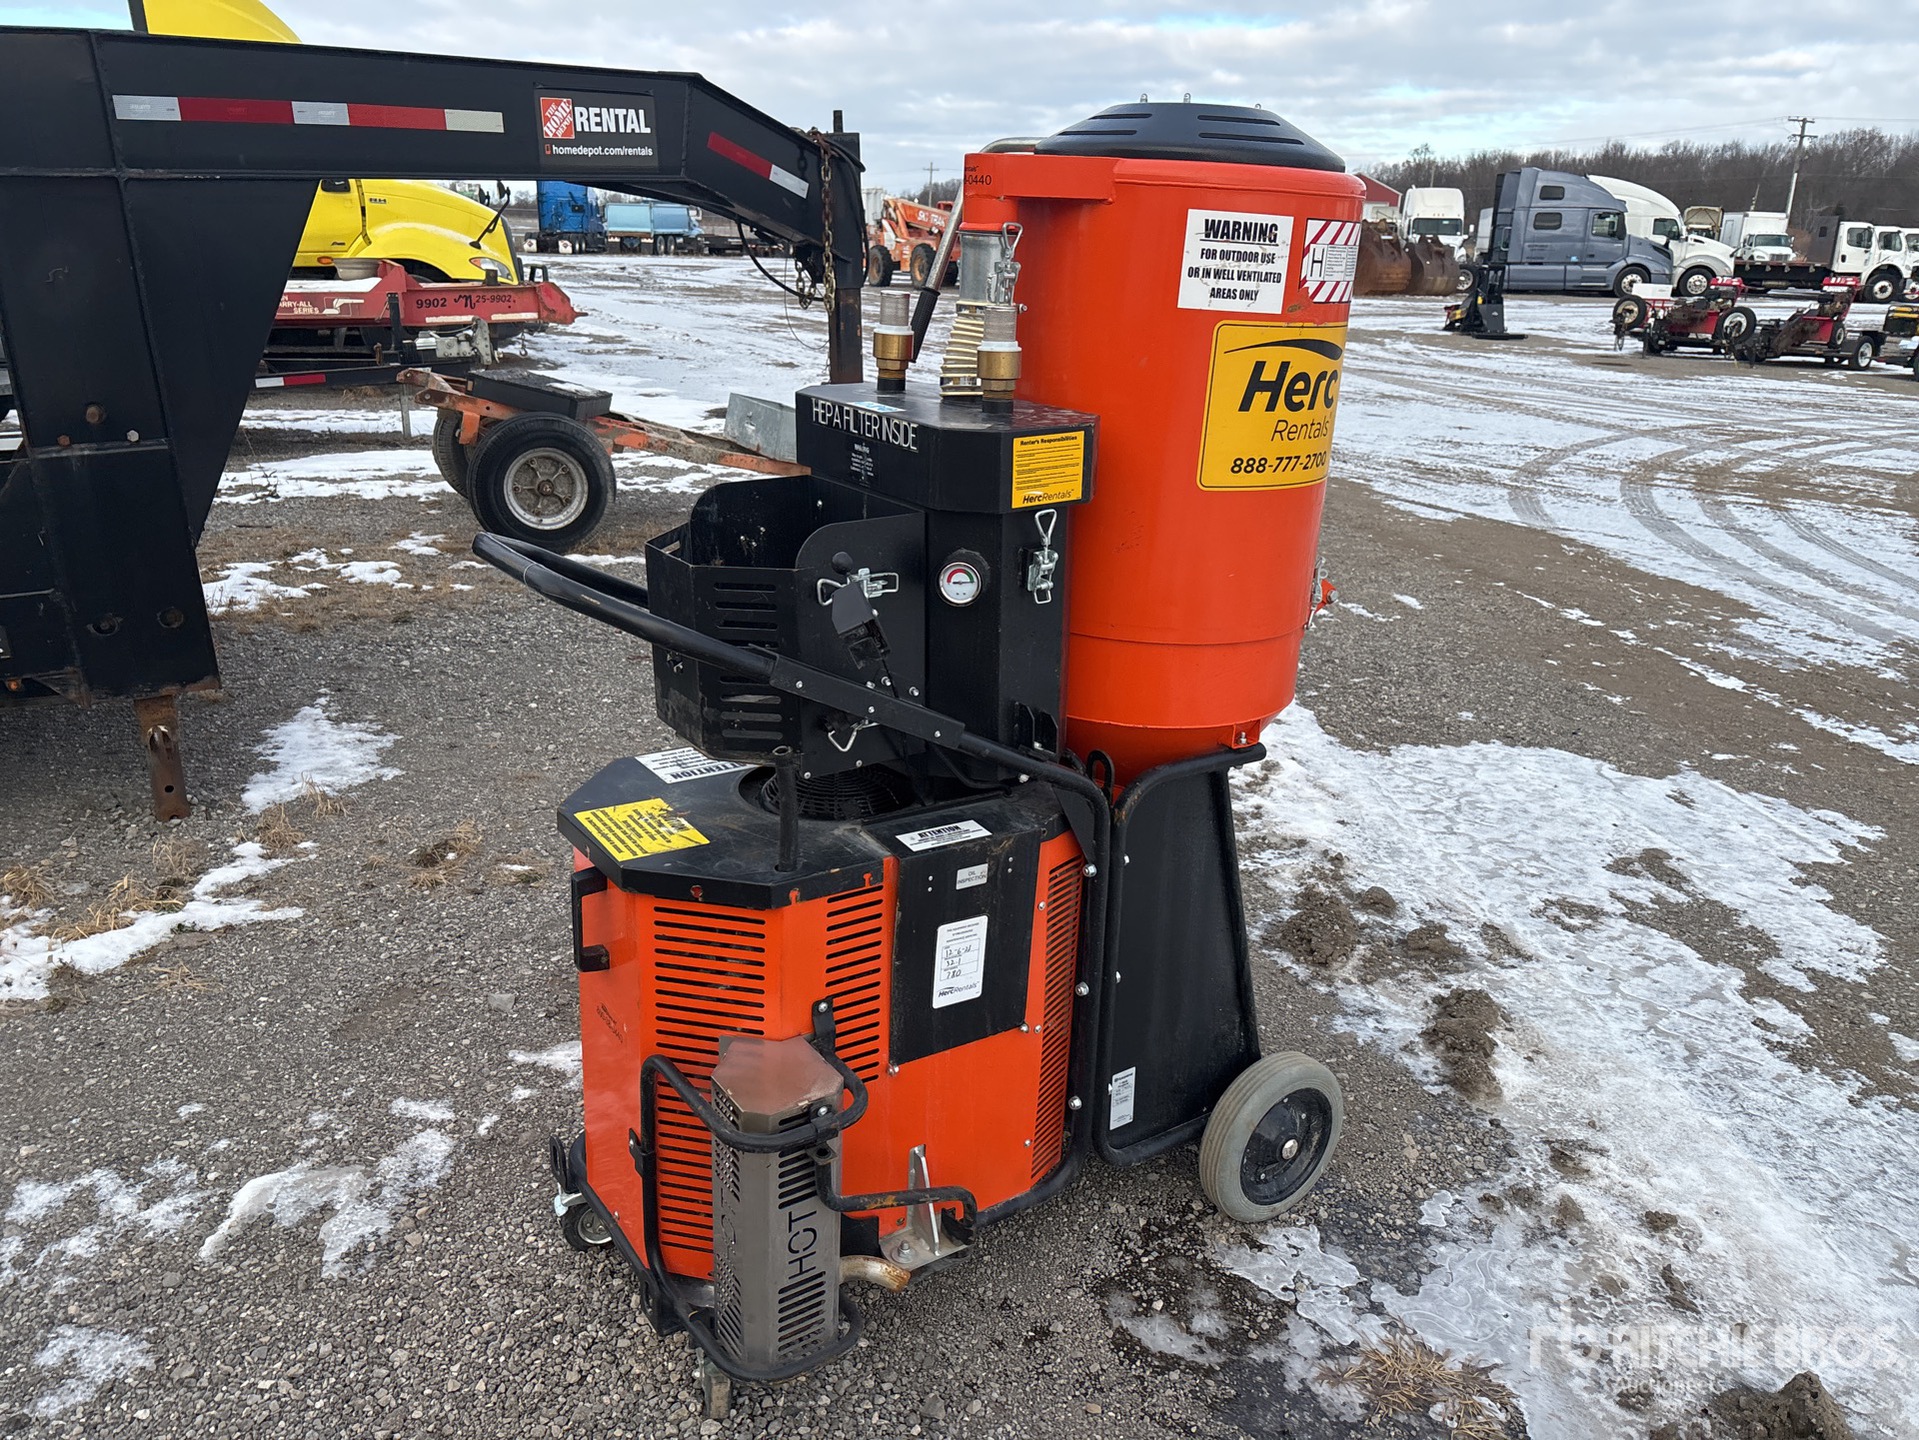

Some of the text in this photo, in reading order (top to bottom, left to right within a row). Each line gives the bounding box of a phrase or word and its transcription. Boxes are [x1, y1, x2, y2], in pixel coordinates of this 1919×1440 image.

[543, 99, 572, 138] HOME
[545, 102, 558, 118] THE
[555, 113, 573, 138] DEPOT
[574, 106, 651, 134] RENTAL
[552, 144, 653, 157] homedepot.com/rentals
[1204, 218, 1279, 244] WARNING
[1200, 248, 1276, 265] FOR OUTDOOR USE
[1310, 247, 1325, 278] H
[1187, 266, 1282, 284] OR IN WELL VENTILATED
[415, 297, 447, 309] 9902
[475, 294, 512, 304] 25-9902
[1209, 287, 1259, 301] AREAS ONLY
[279, 300, 312, 308] ARRY-ALL
[294, 307, 319, 315] SERIES
[1238, 360, 1339, 413] Herc
[811, 397, 919, 451] HEPA FILTER INSIDE
[1270, 417, 1329, 442] Rentals
[1041, 435, 1078, 445] Responsibilities
[1230, 451, 1327, 475] 888-777-2700
[1022, 489, 1072, 505] HercRentals
[917, 824, 962, 839] ATTENTION
[788, 1210, 818, 1280] HOT
